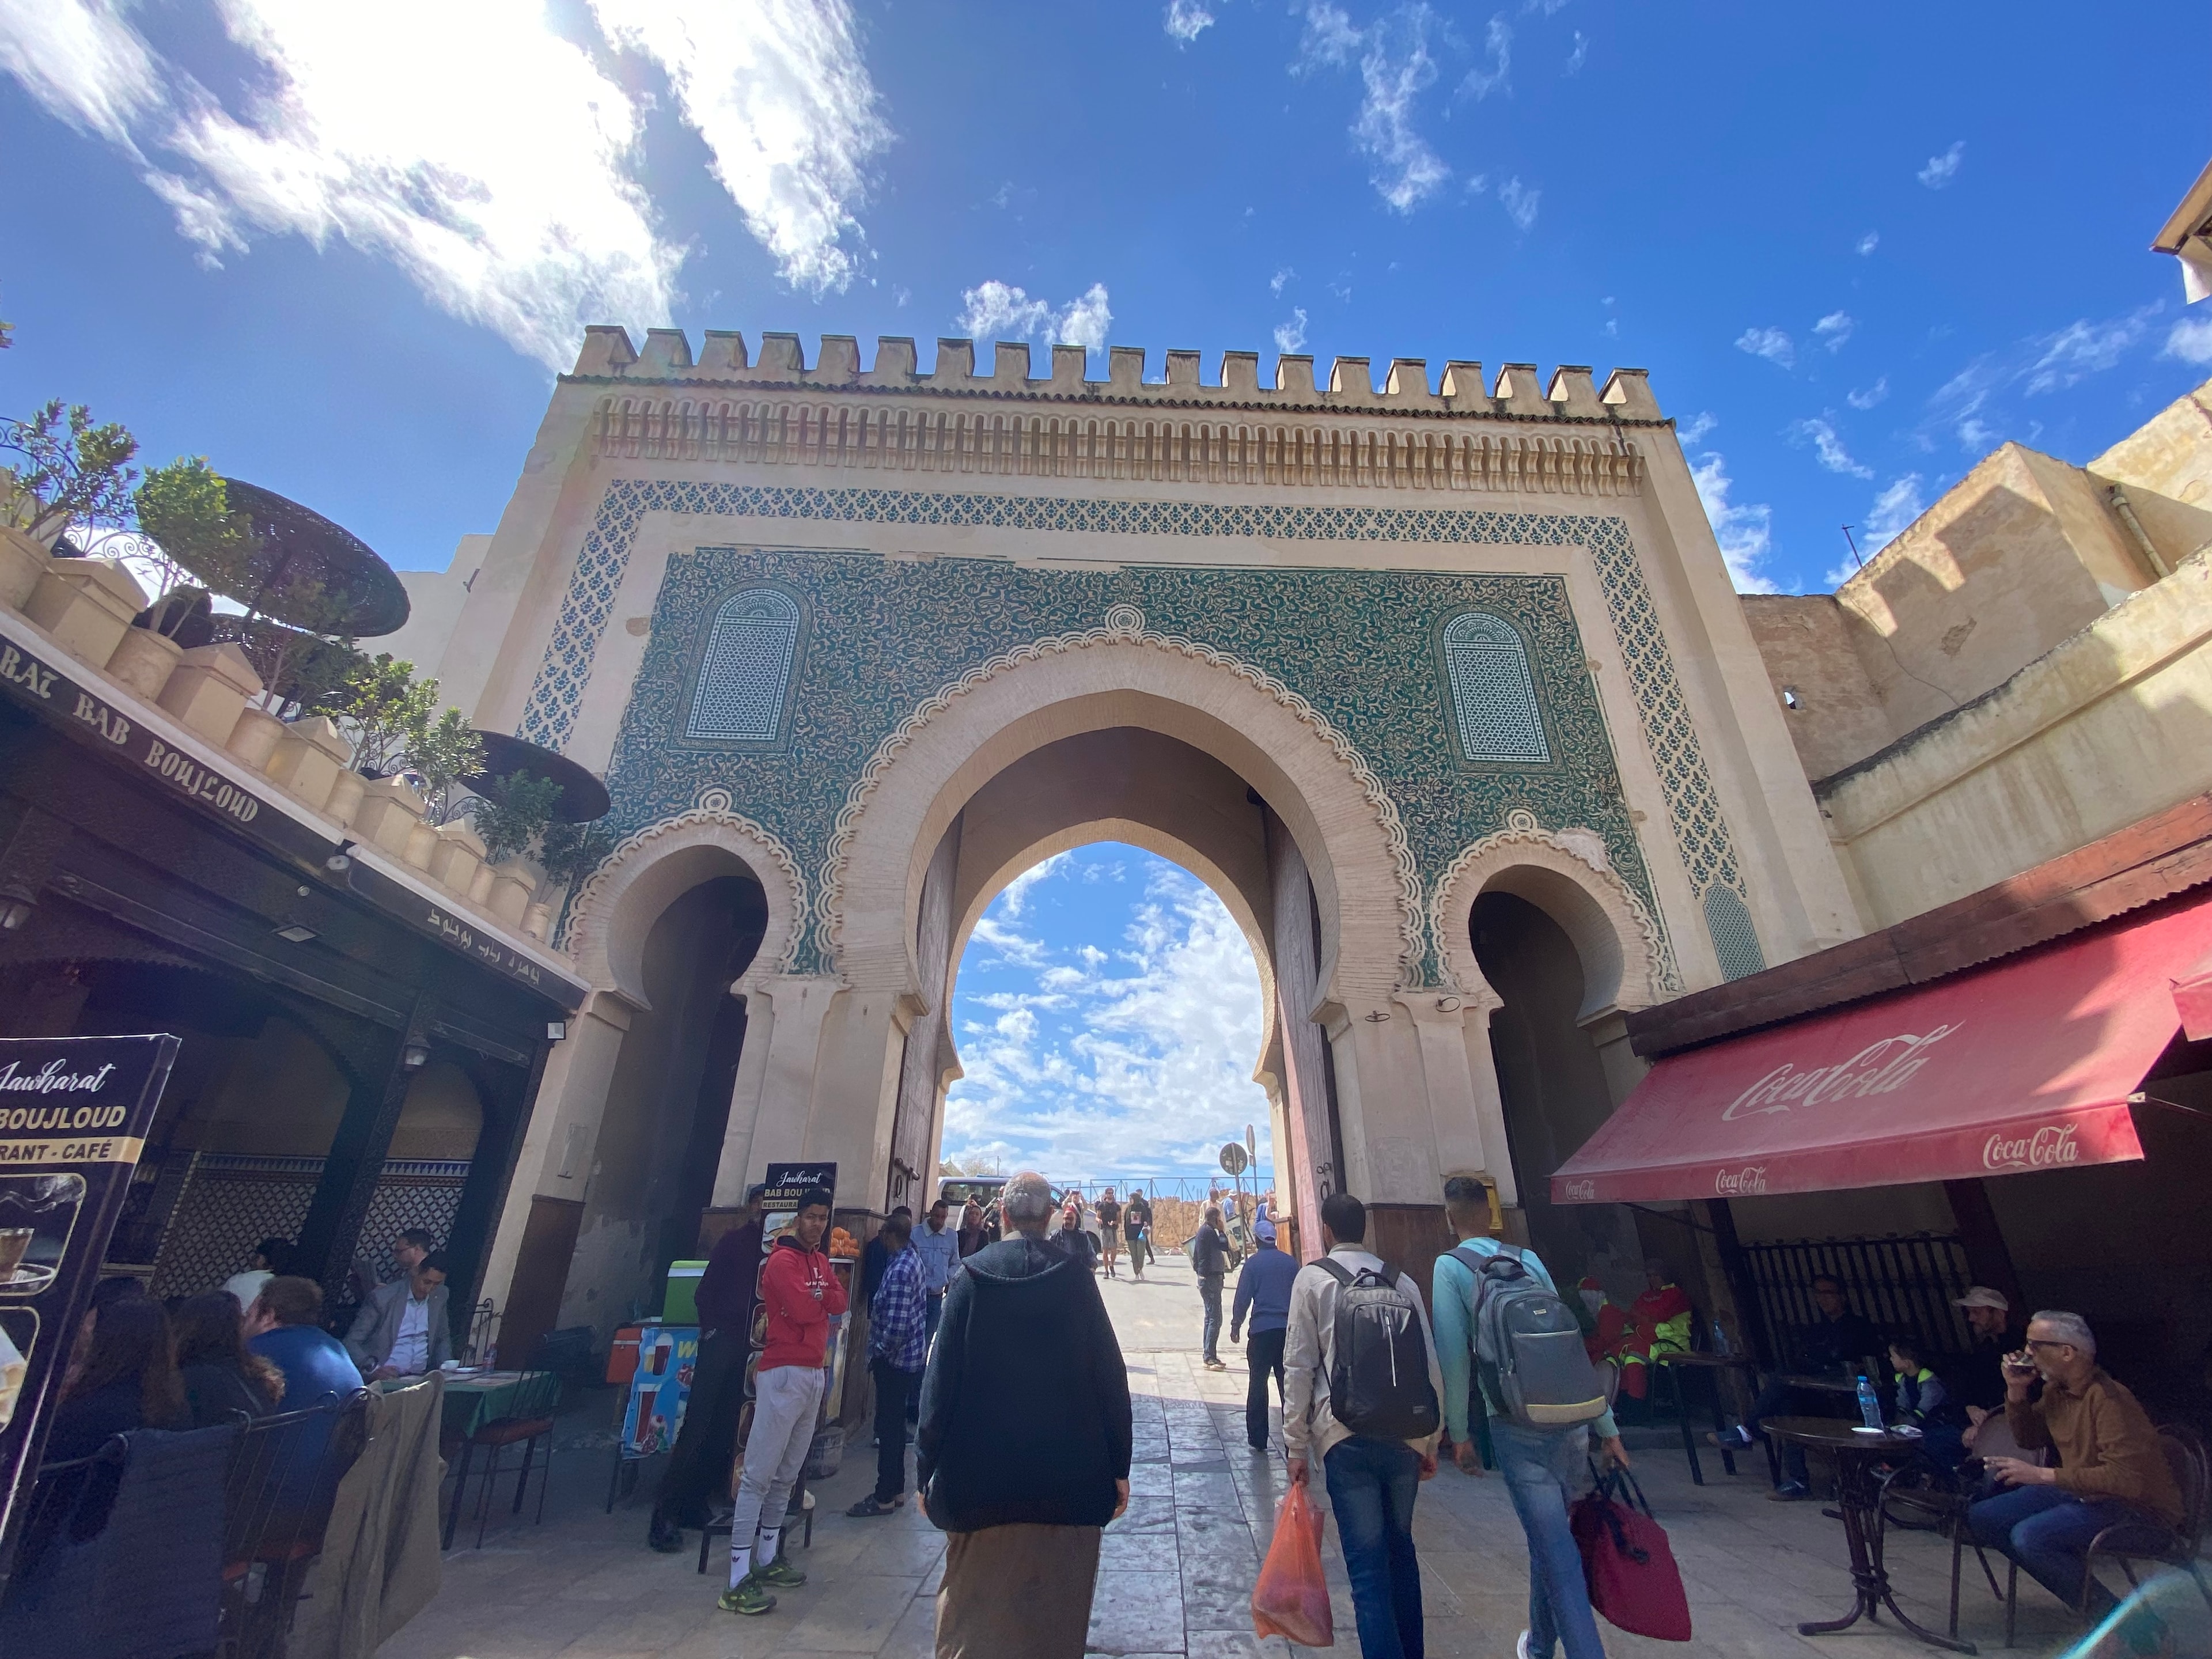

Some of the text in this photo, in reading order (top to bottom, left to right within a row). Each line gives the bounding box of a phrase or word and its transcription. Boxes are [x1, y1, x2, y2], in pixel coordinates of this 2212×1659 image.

[73, 693, 130, 745] BAB
[1722, 1019, 1967, 1122] Coca-Cola
[0, 1105, 126, 1130] BOUJLOUD
[62, 1139, 112, 1159] CAFÉ
[1983, 1124, 2080, 1170] Coca-Cola
[776, 1170, 823, 1187] Jawharat
[1715, 1166, 1766, 1195] Coca-Cola
[764, 1188, 782, 1197] BAB
